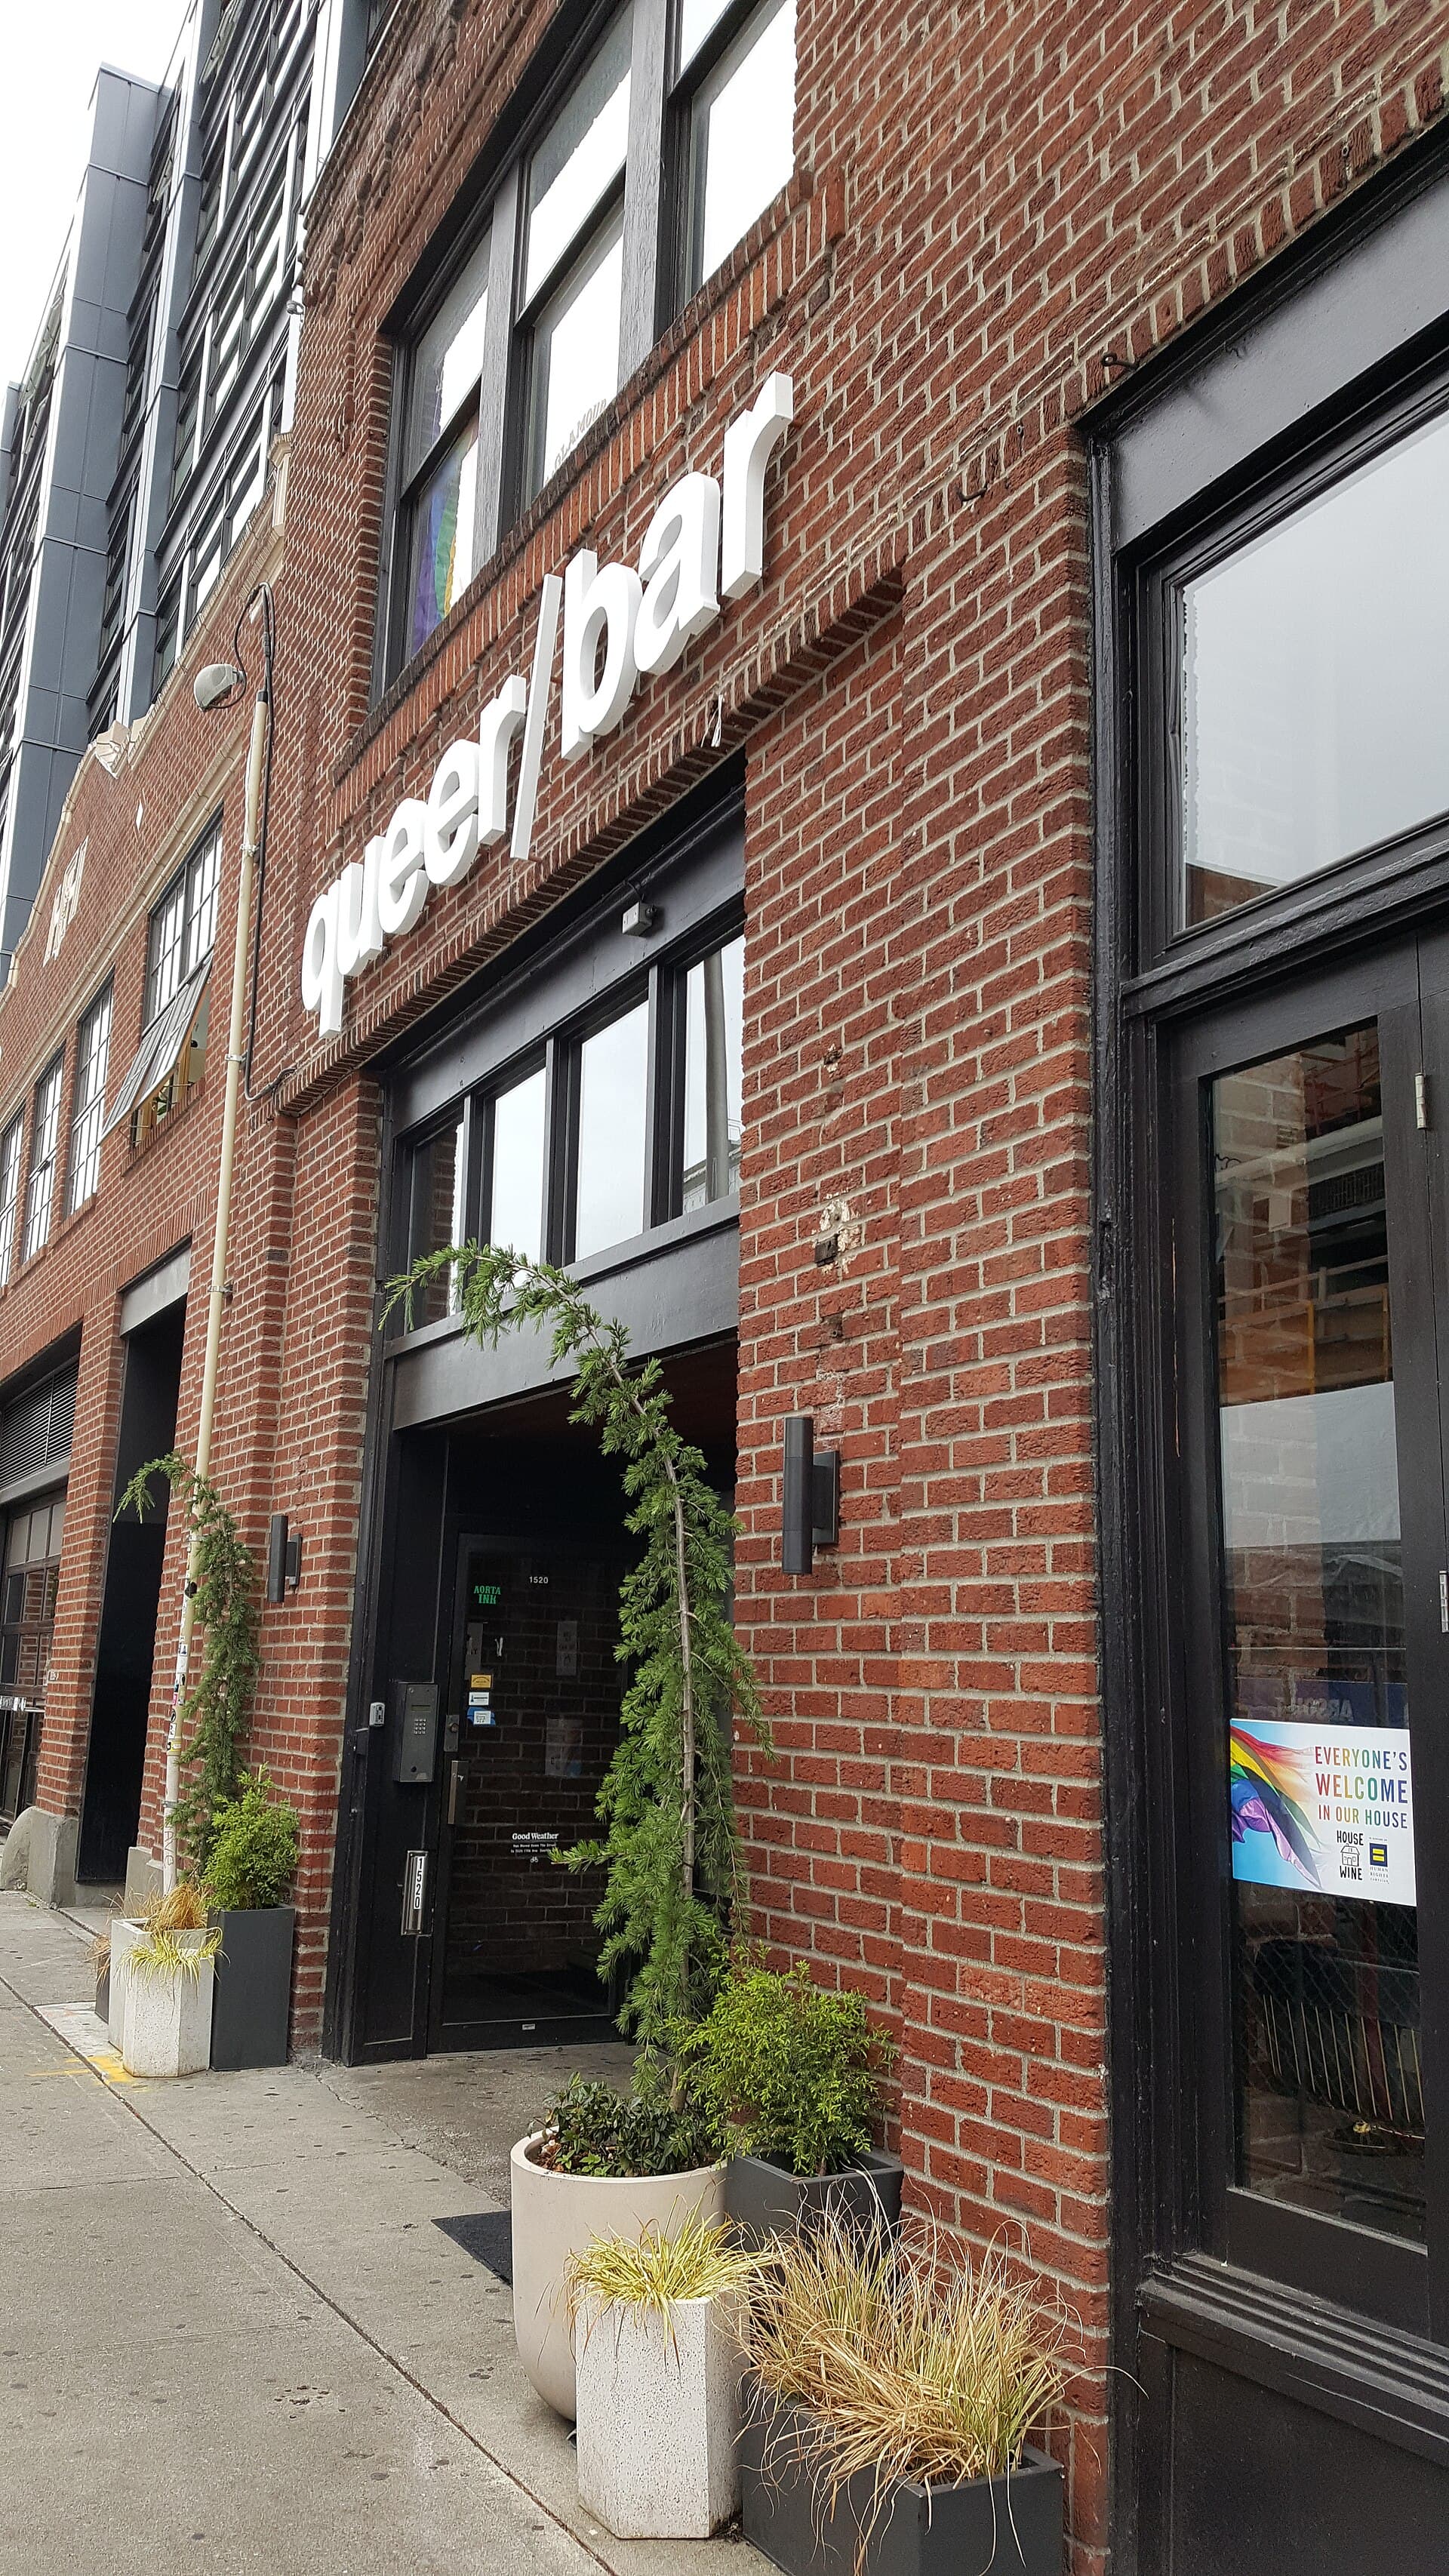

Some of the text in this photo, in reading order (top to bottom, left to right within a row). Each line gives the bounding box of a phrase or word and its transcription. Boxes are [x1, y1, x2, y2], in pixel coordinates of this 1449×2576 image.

[301, 371, 793, 1039] queer/bar
[473, 1585, 501, 1595] AORTA
[478, 1594, 497, 1605] INK
[1315, 1746, 1407, 1771] EVERYONE'S
[1315, 1773, 1408, 1804] WELCOME
[1318, 1805, 1407, 1829] IN OUR HOUSE
[512, 1832, 559, 1840] Good Weather
[1337, 1830, 1364, 1845] HOUSE
[1340, 1865, 1363, 1880] WINE
[414, 1857, 423, 1908] 1520
